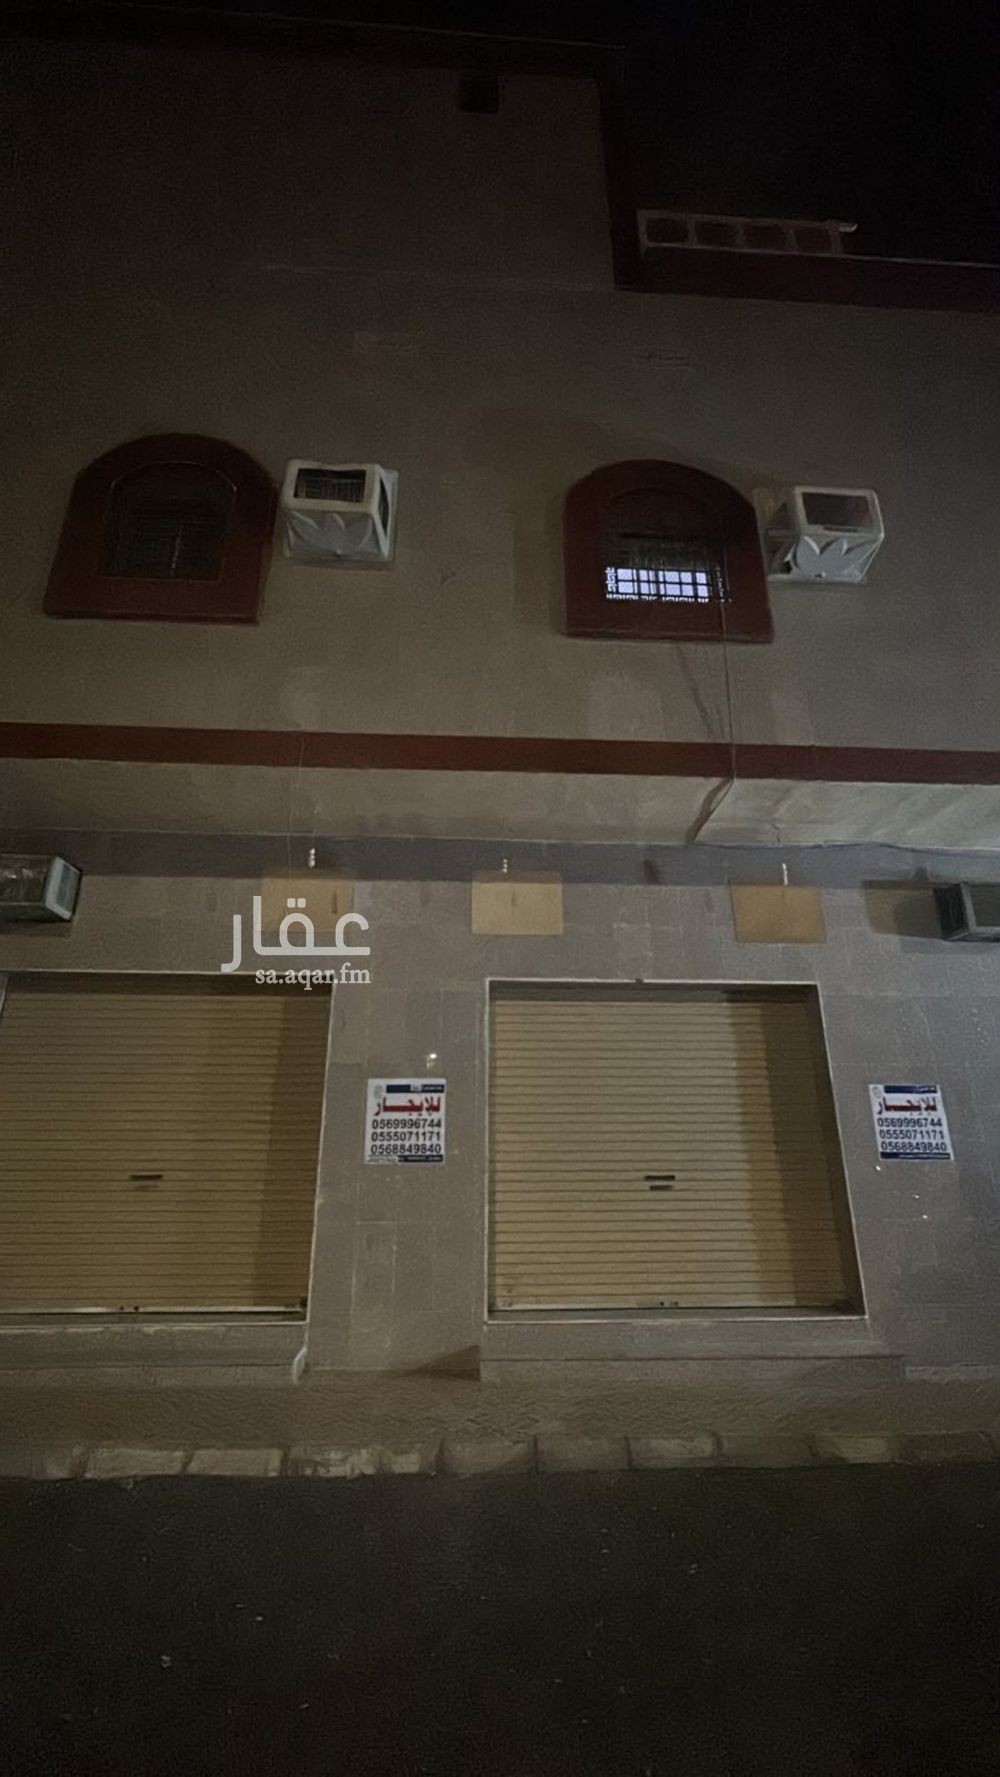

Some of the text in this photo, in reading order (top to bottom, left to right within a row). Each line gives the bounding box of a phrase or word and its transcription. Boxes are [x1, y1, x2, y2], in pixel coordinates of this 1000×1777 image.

[372, 1119, 441, 1129] 0569996744
[877, 1118, 942, 1128] 0569996744
[371, 1131, 441, 1142] 0555071171
[880, 1130, 944, 1140] 0555071171
[371, 1143, 441, 1154] 0568849840
[881, 1141, 947, 1152] 0568849840
